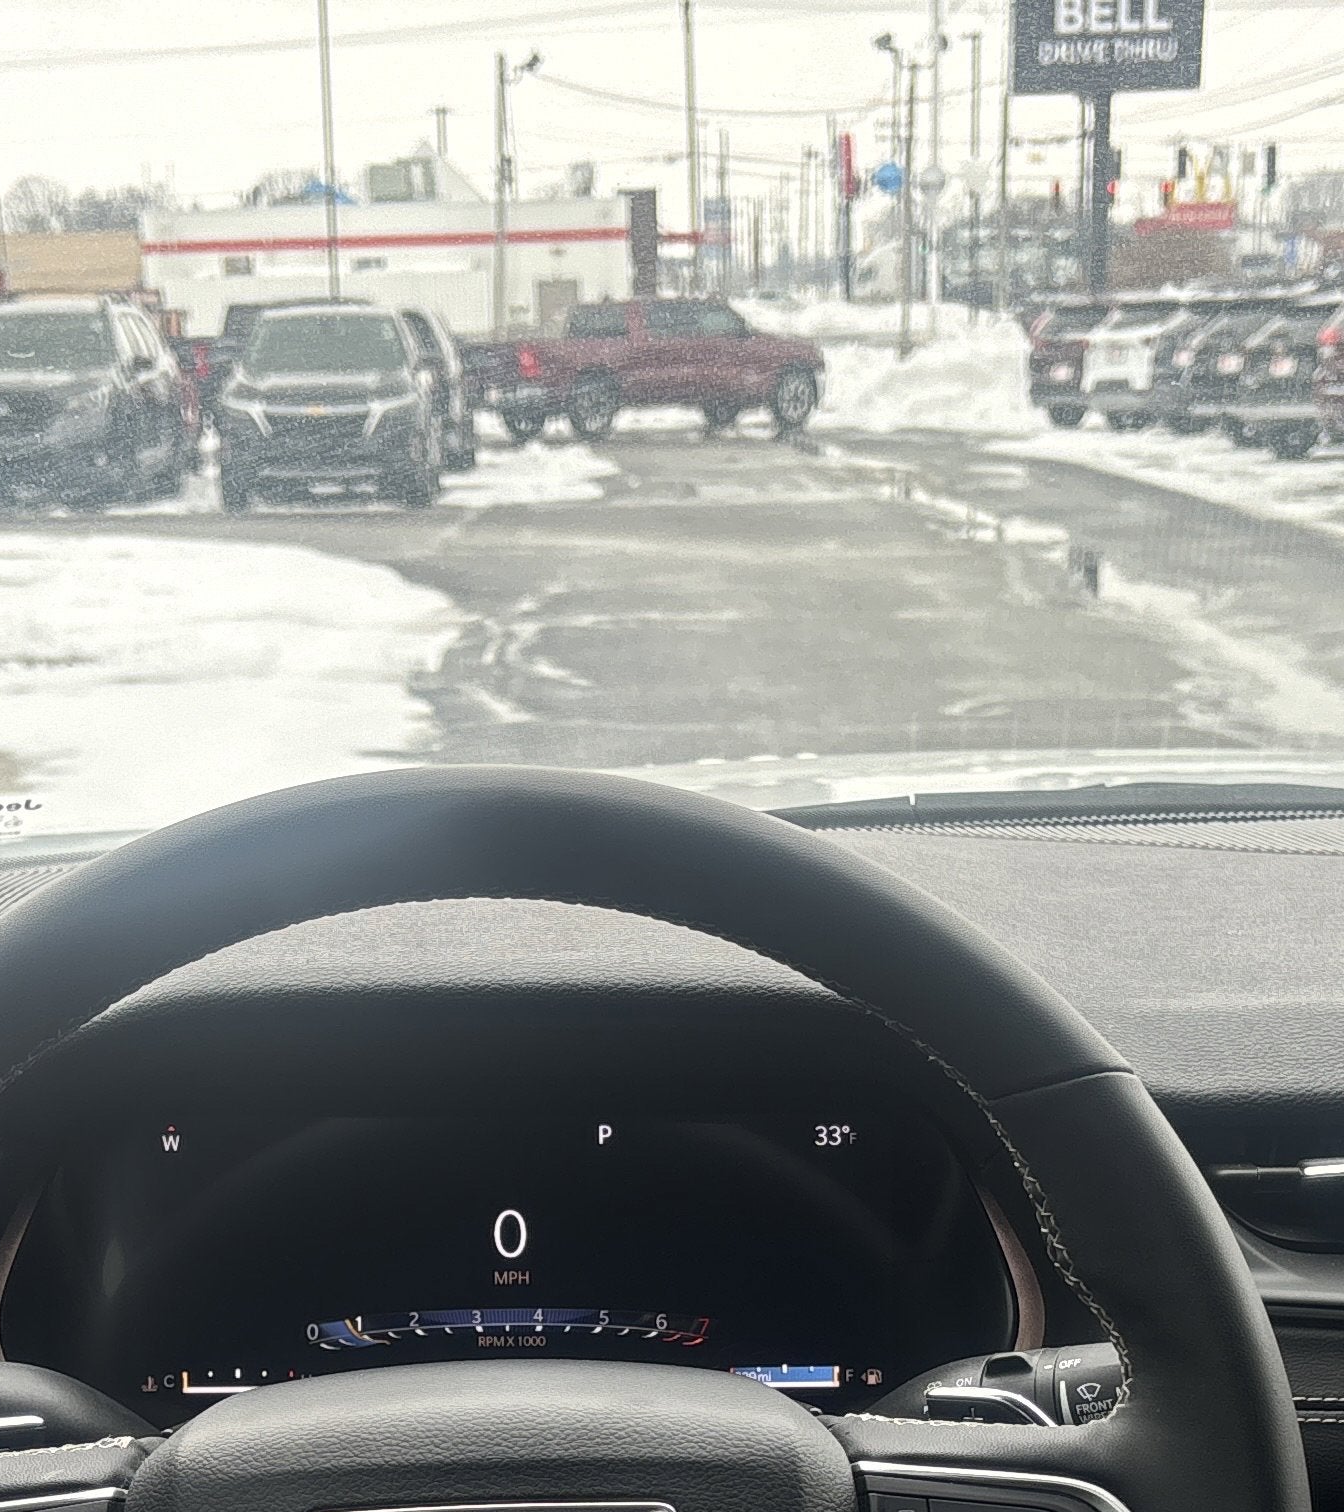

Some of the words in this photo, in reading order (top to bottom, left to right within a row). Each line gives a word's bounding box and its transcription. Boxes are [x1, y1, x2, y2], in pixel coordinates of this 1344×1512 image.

[1054, 0, 1173, 34] BELL
[161, 1134, 180, 1152] W
[598, 1125, 612, 1145] P
[494, 1210, 527, 1258] 0
[494, 1271, 530, 1286] MPH
[307, 1324, 319, 1340] 0
[355, 1316, 362, 1331] 1
[409, 1312, 420, 1327] 2
[472, 1310, 482, 1324] 3
[533, 1309, 543, 1322] 4
[599, 1310, 609, 1325] 5
[656, 1314, 667, 1329] 6
[697, 1318, 709, 1336] 7
[478, 1336, 505, 1347] RPM
[518, 1336, 547, 1347] 1000
[1059, 1358, 1082, 1369] OFF
[163, 1375, 175, 1388] C
[845, 1369, 854, 1382] F
[956, 1377, 972, 1387] ON
[1075, 1399, 1113, 1416] FRONT
